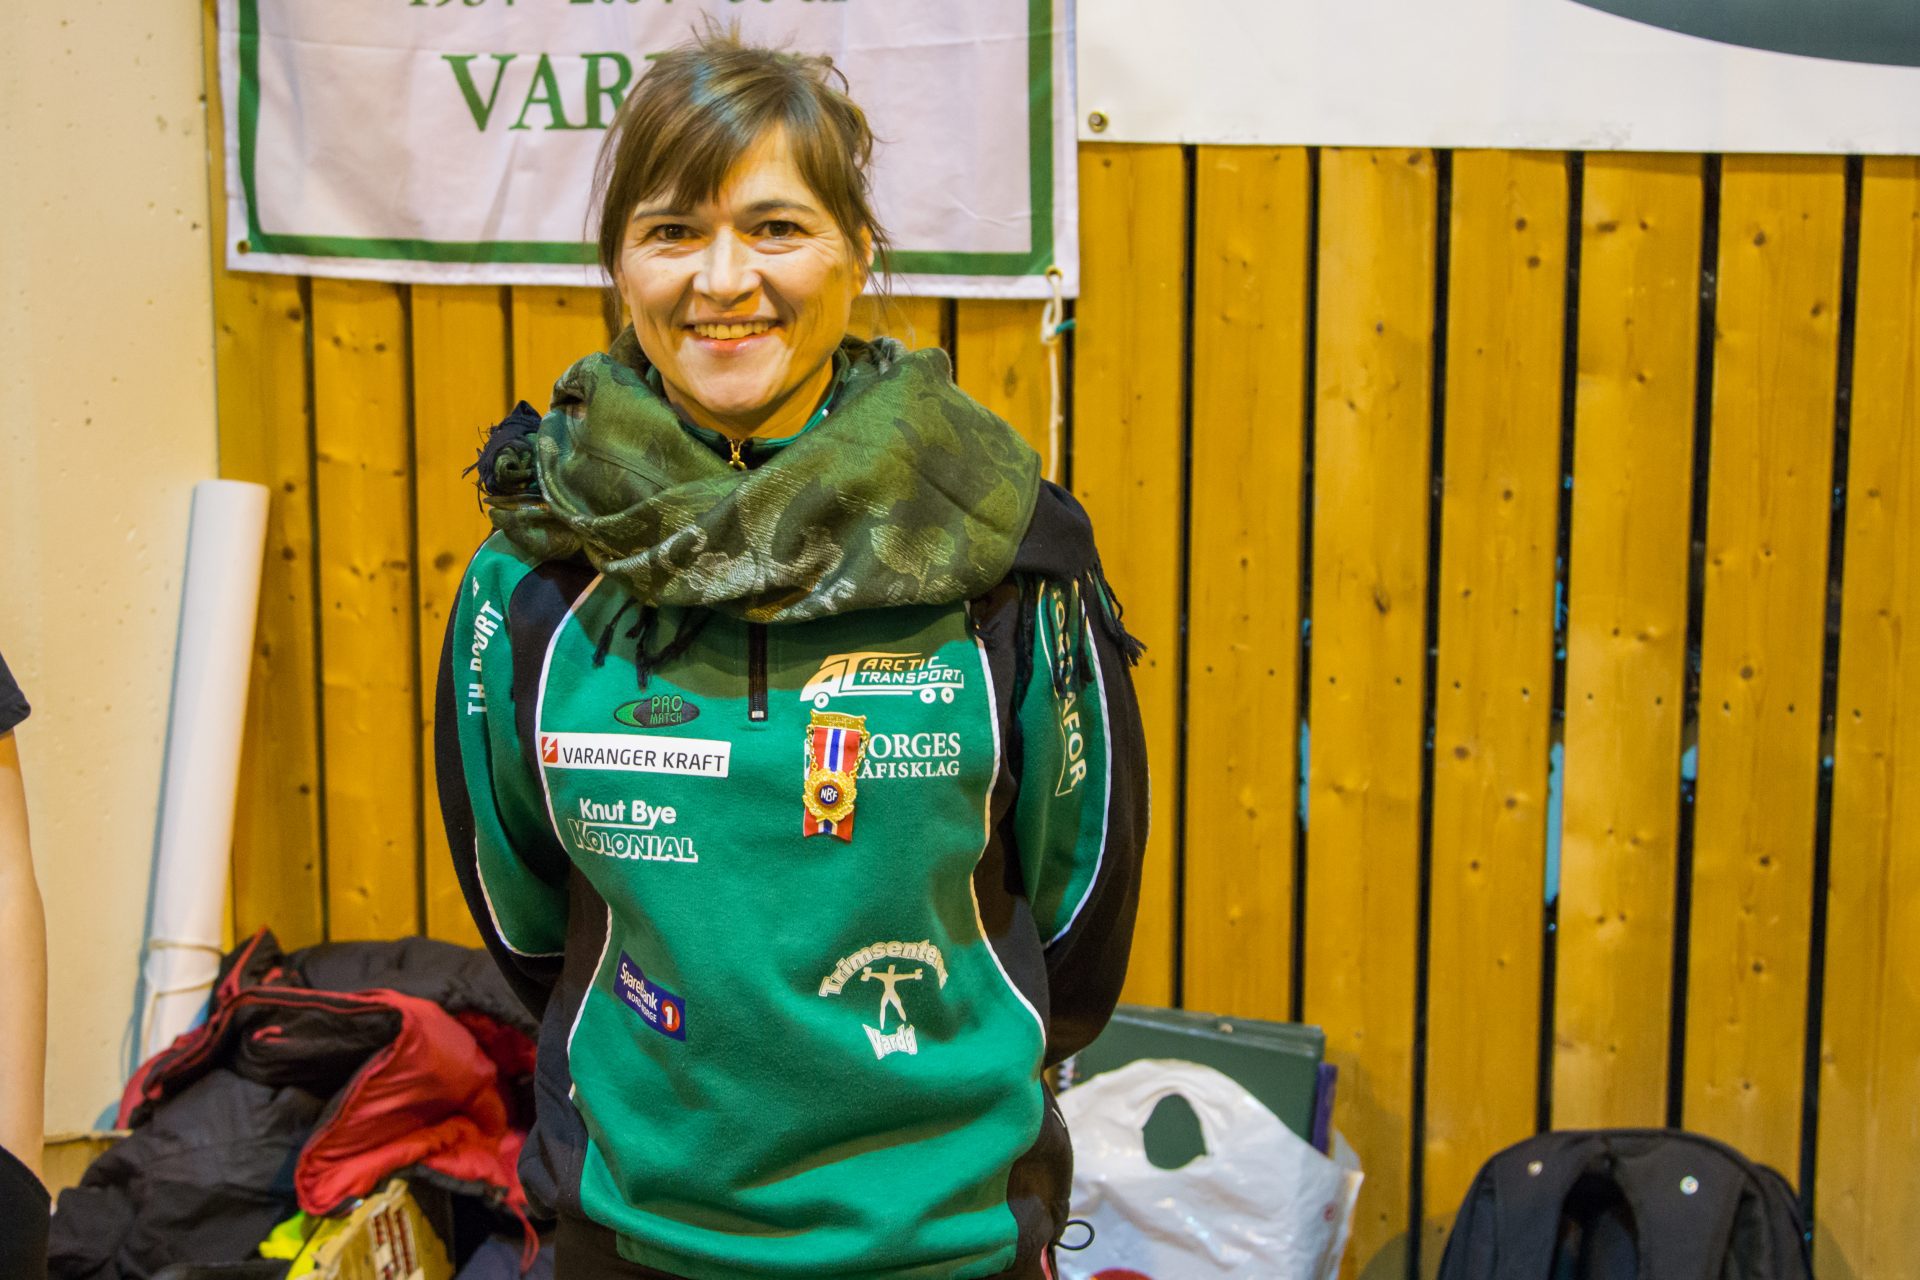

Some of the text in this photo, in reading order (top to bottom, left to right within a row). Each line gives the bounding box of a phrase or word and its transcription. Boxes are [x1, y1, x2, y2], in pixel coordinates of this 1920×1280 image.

[441, 52, 672, 133] VAR
[863, 656, 949, 671] ARCTIC
[860, 669, 961, 684] TRANSPORT
[651, 695, 683, 712] PRO
[650, 711, 682, 724] MATCH
[868, 733, 961, 759] ORGES
[563, 747, 725, 772] VARANGER KRAFT
[858, 759, 960, 779] ÅFISKLAG
[820, 787, 839, 803] NBF
[580, 798, 677, 830] Knut Bye
[567, 818, 699, 863] KOLONIAL
